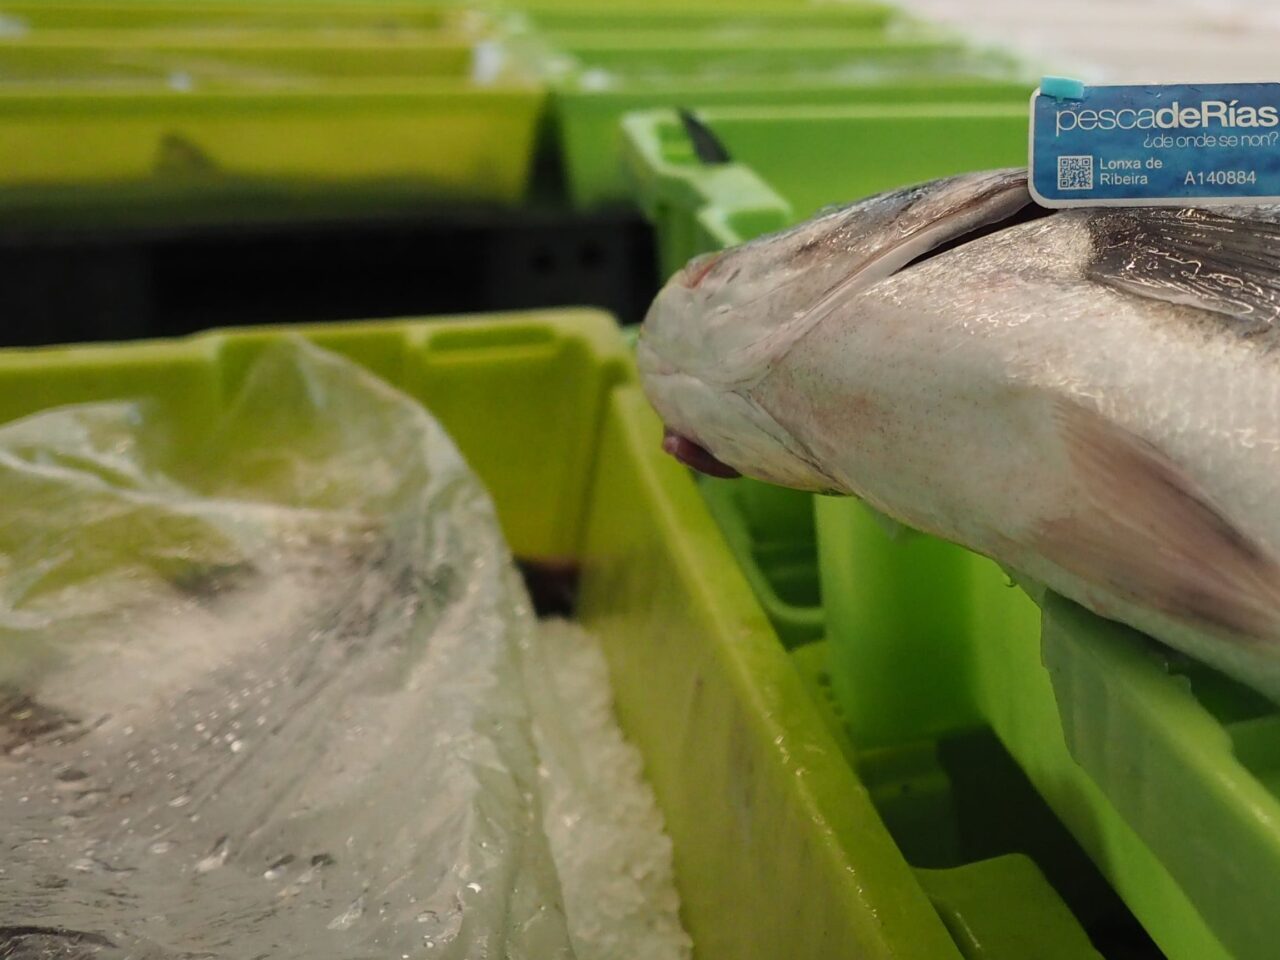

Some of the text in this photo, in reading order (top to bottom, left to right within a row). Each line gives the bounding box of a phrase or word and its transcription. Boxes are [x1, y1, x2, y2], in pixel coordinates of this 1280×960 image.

[1056, 100, 1279, 136] pescadeRías
[1143, 131, 1279, 148] ¿de onde se non?
[1099, 157, 1163, 170] Lonxa de
[1099, 172, 1149, 185] Ribeira
[1184, 170, 1257, 186] A140884
